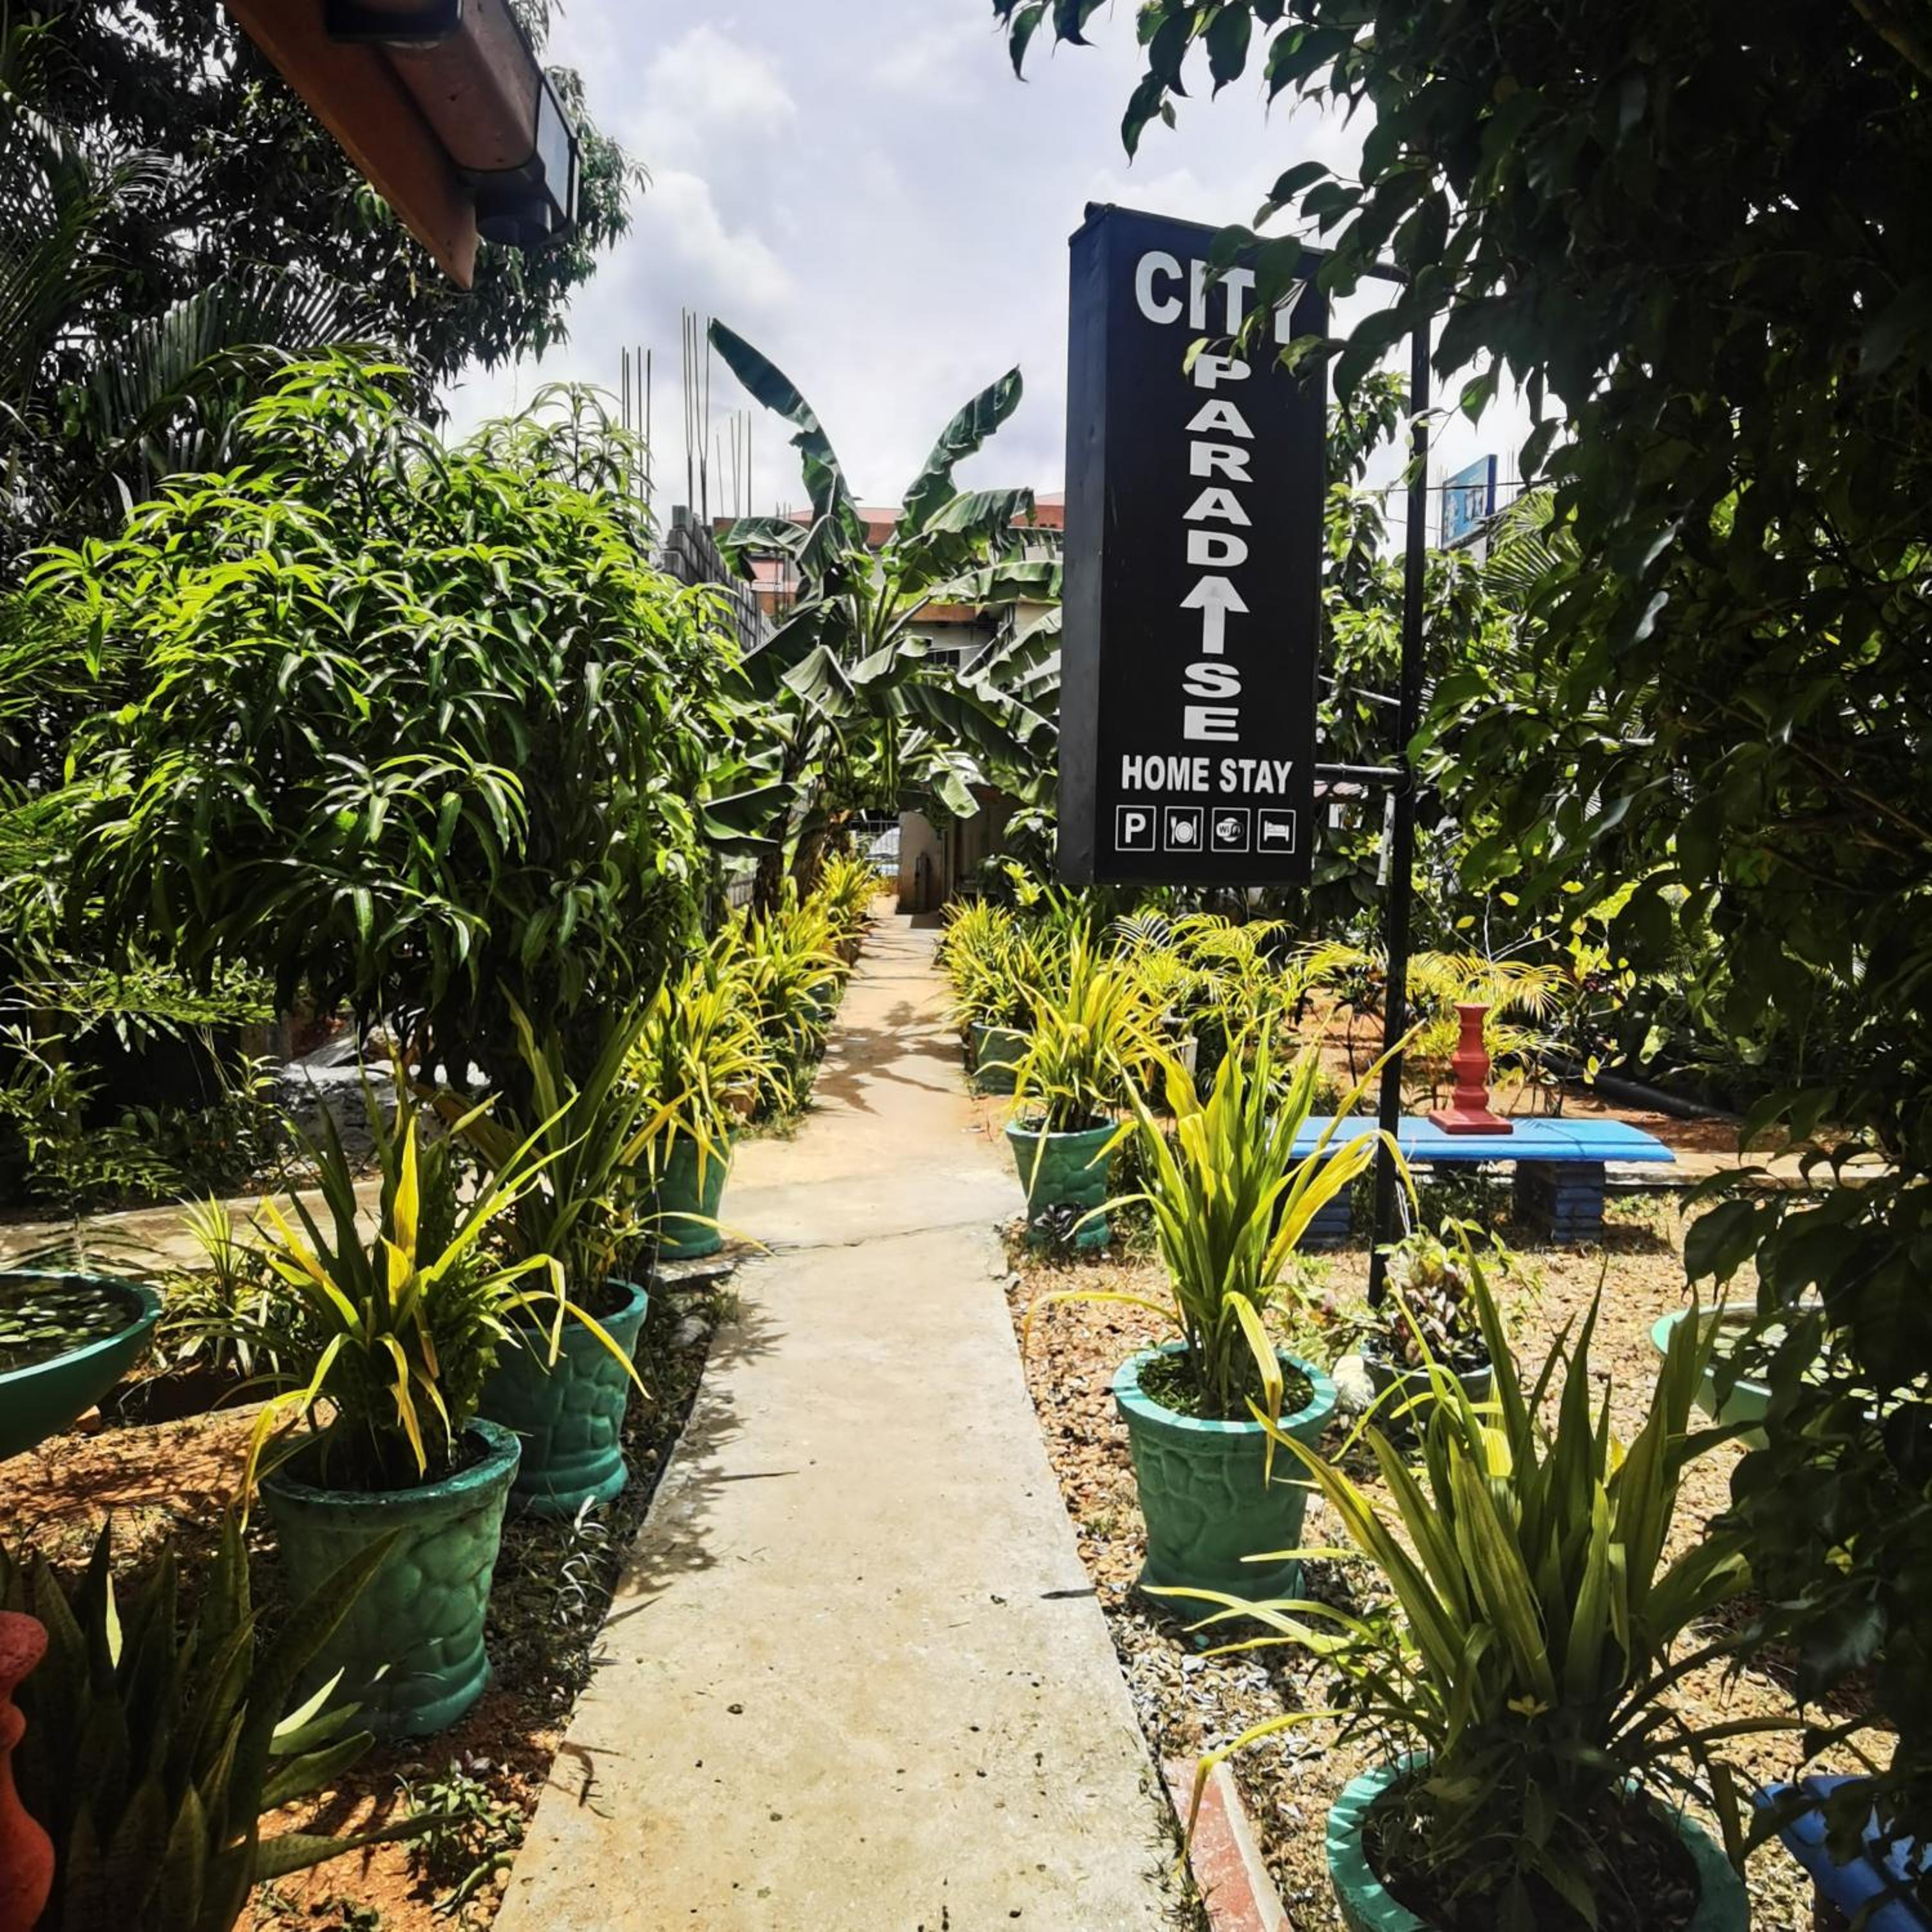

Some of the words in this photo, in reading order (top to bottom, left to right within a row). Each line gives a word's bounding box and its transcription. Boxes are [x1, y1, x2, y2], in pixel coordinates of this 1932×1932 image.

[1135, 251, 1307, 345] CITY
[1121, 754, 1210, 791] HOME
[1219, 758, 1293, 794] STAY
[1125, 813, 1146, 843] P
